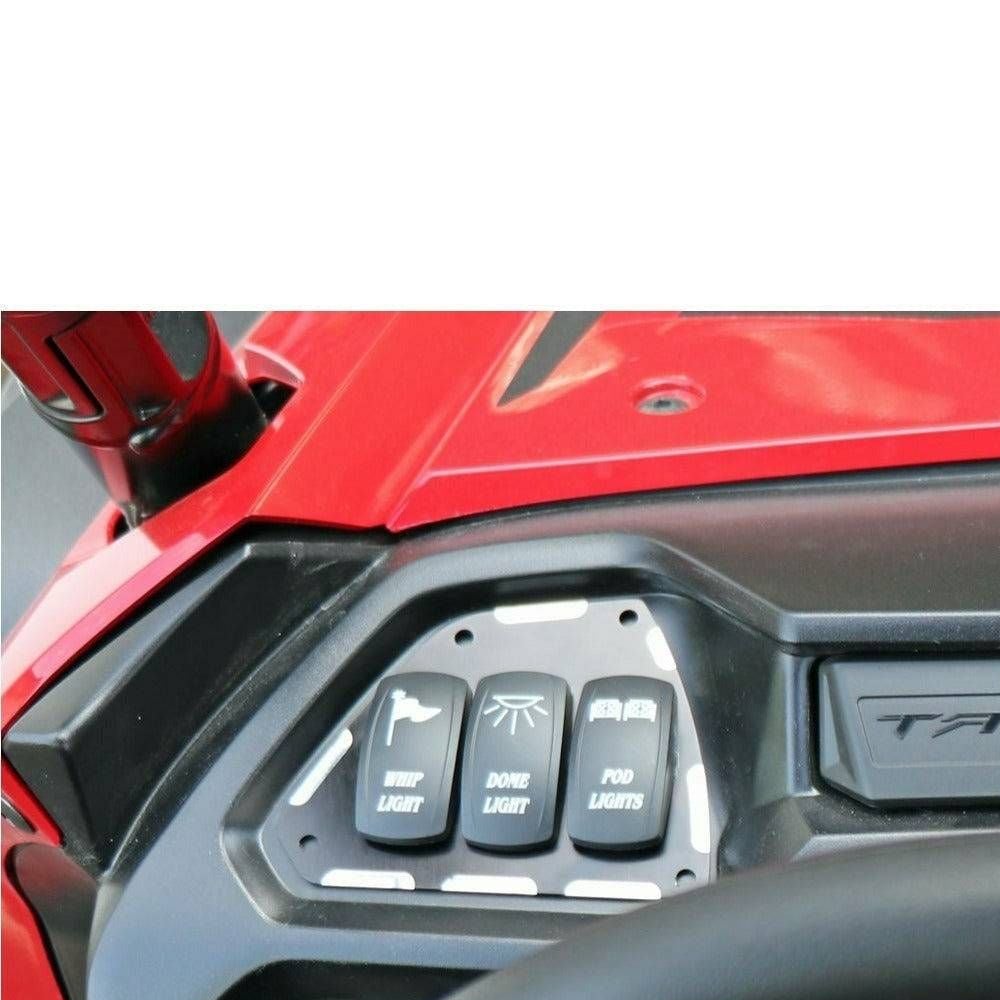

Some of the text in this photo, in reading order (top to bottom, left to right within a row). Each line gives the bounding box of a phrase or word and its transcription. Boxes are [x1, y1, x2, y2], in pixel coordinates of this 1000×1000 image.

[383, 770, 424, 788] WHIP
[485, 772, 531, 789] DOME
[601, 768, 634, 785] POD
[376, 795, 424, 814] LIGHT
[482, 796, 531, 815] LIGHT
[587, 792, 644, 810] LIGHTS
